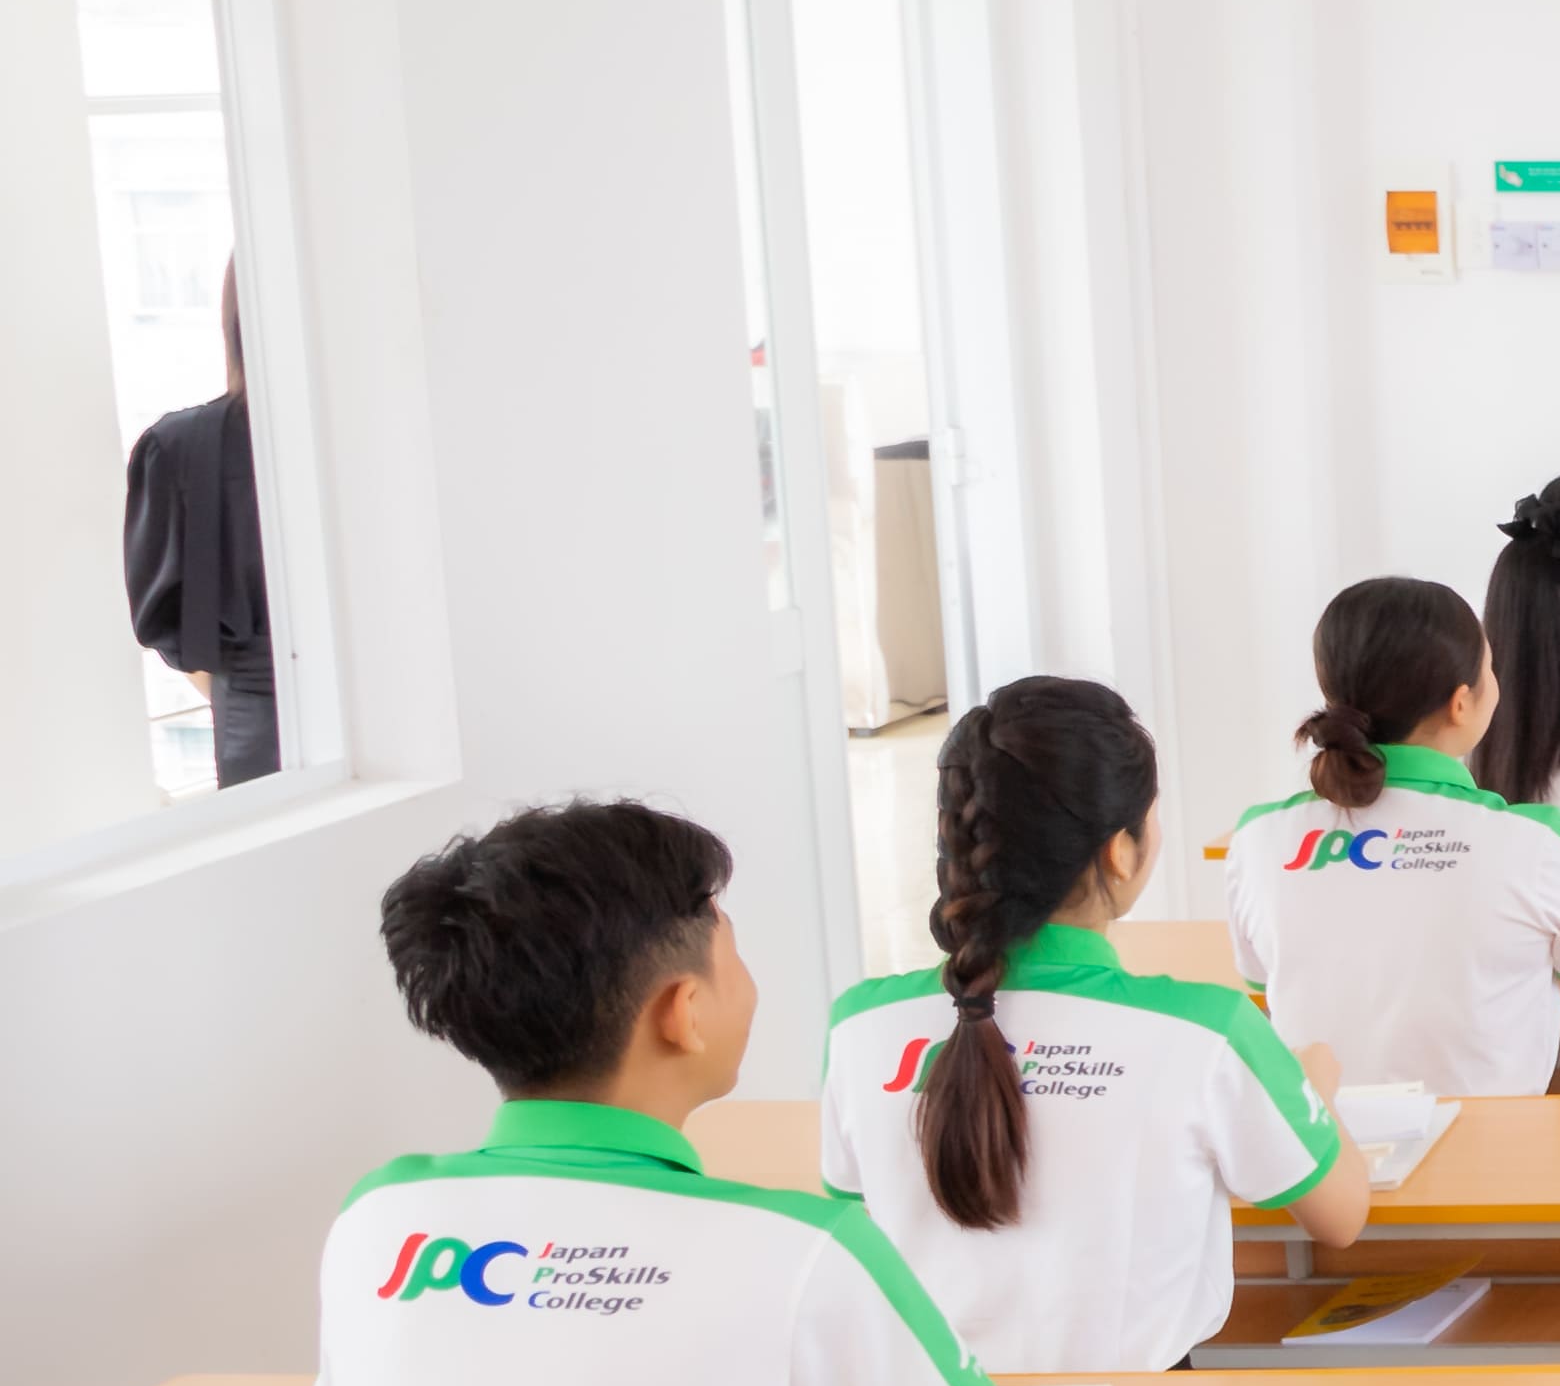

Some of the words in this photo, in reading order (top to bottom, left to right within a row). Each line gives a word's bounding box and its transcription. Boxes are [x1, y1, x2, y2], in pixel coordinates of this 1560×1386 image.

[1394, 827, 1446, 841] Japan
[1283, 829, 1388, 871] JPC
[1392, 842, 1471, 855] ProSkills
[1391, 857, 1458, 873] College
[1023, 1041, 1091, 1058] Japan
[1021, 1061, 1125, 1078] ProSkills
[1020, 1080, 1107, 1100] College
[538, 1242, 630, 1264] Japan
[376, 1232, 529, 1307] JPC
[531, 1266, 672, 1286] ProSkills
[528, 1291, 644, 1316] College
